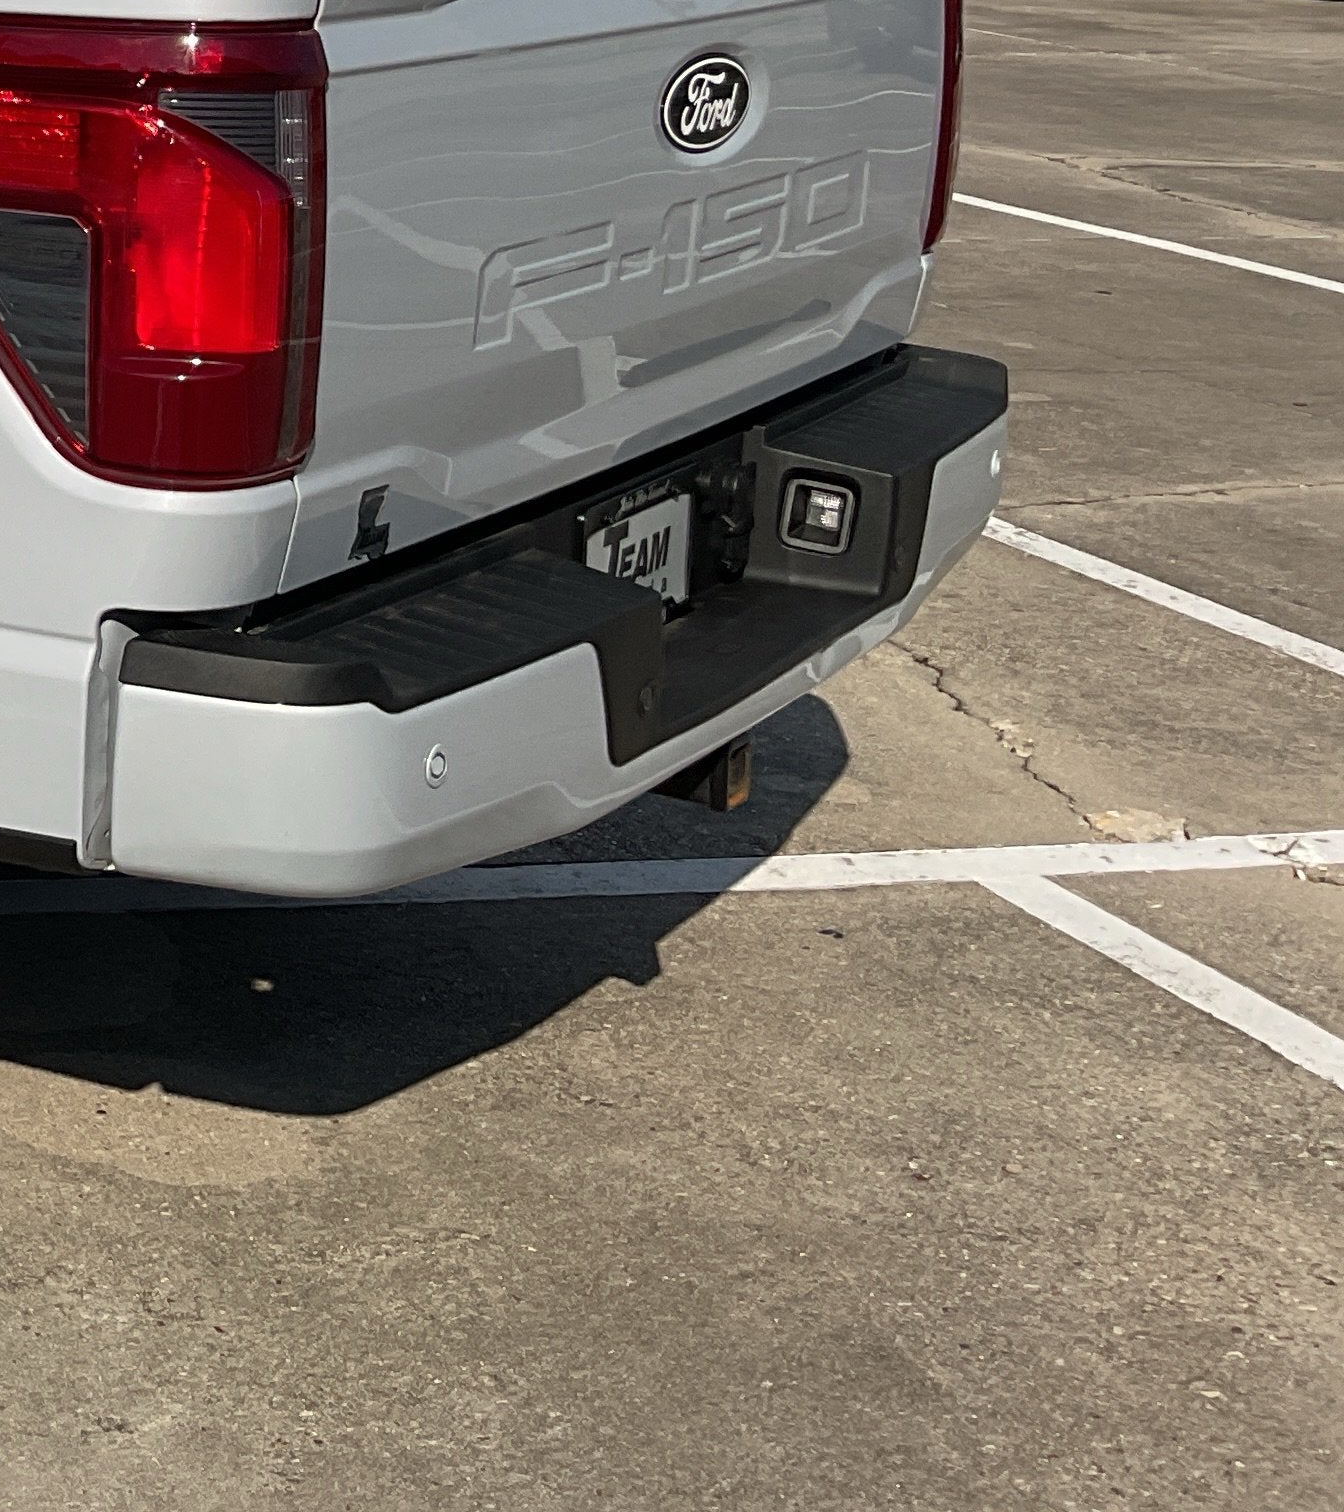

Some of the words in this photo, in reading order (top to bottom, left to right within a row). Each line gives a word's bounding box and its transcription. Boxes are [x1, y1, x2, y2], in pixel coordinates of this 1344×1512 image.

[680, 71, 739, 136] Ford
[473, 148, 872, 352] F-150
[603, 520, 672, 579] TEAM
